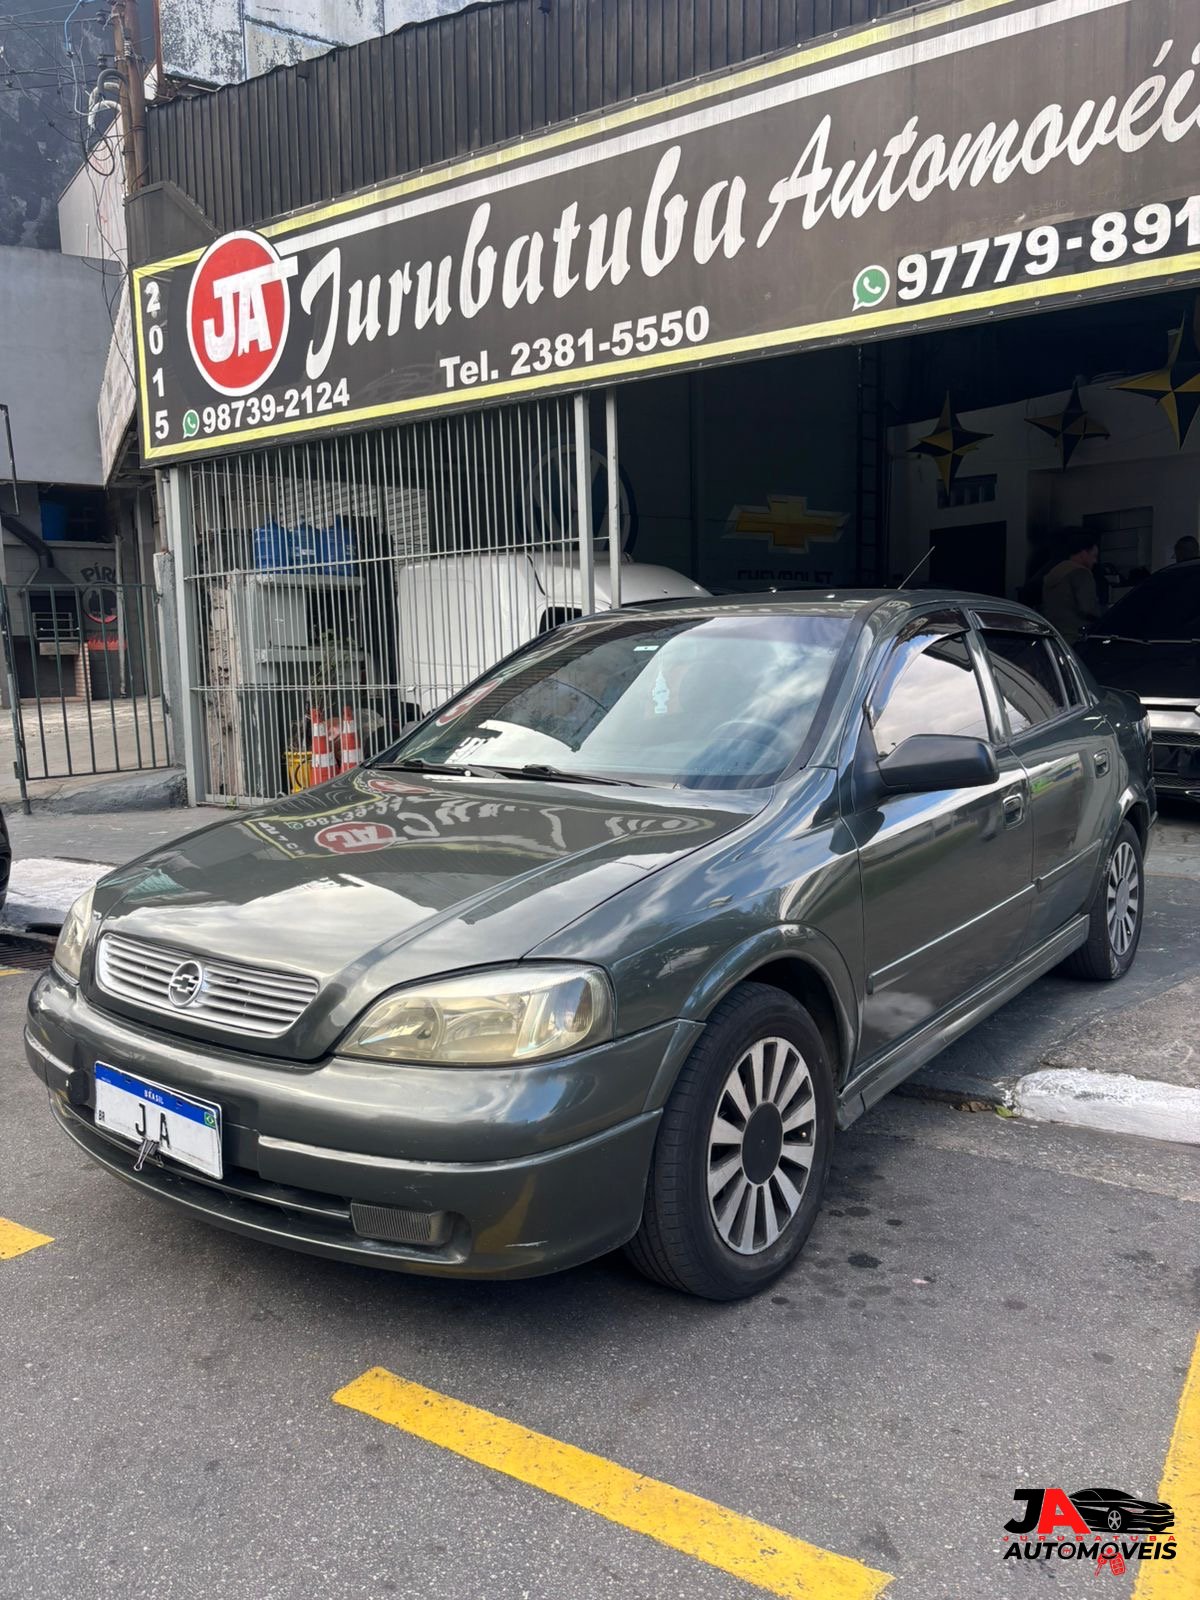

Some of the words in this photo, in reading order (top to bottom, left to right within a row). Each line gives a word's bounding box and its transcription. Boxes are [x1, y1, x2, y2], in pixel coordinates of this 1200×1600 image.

[300, 145, 747, 380] Jurubatuba
[756, 39, 1200, 249] Automovéi
[440, 350, 499, 388] Tel.
[510, 305, 710, 376] 2381-5550
[202, 378, 350, 434] 98739-2124
[80, 562, 117, 584] PÍR
